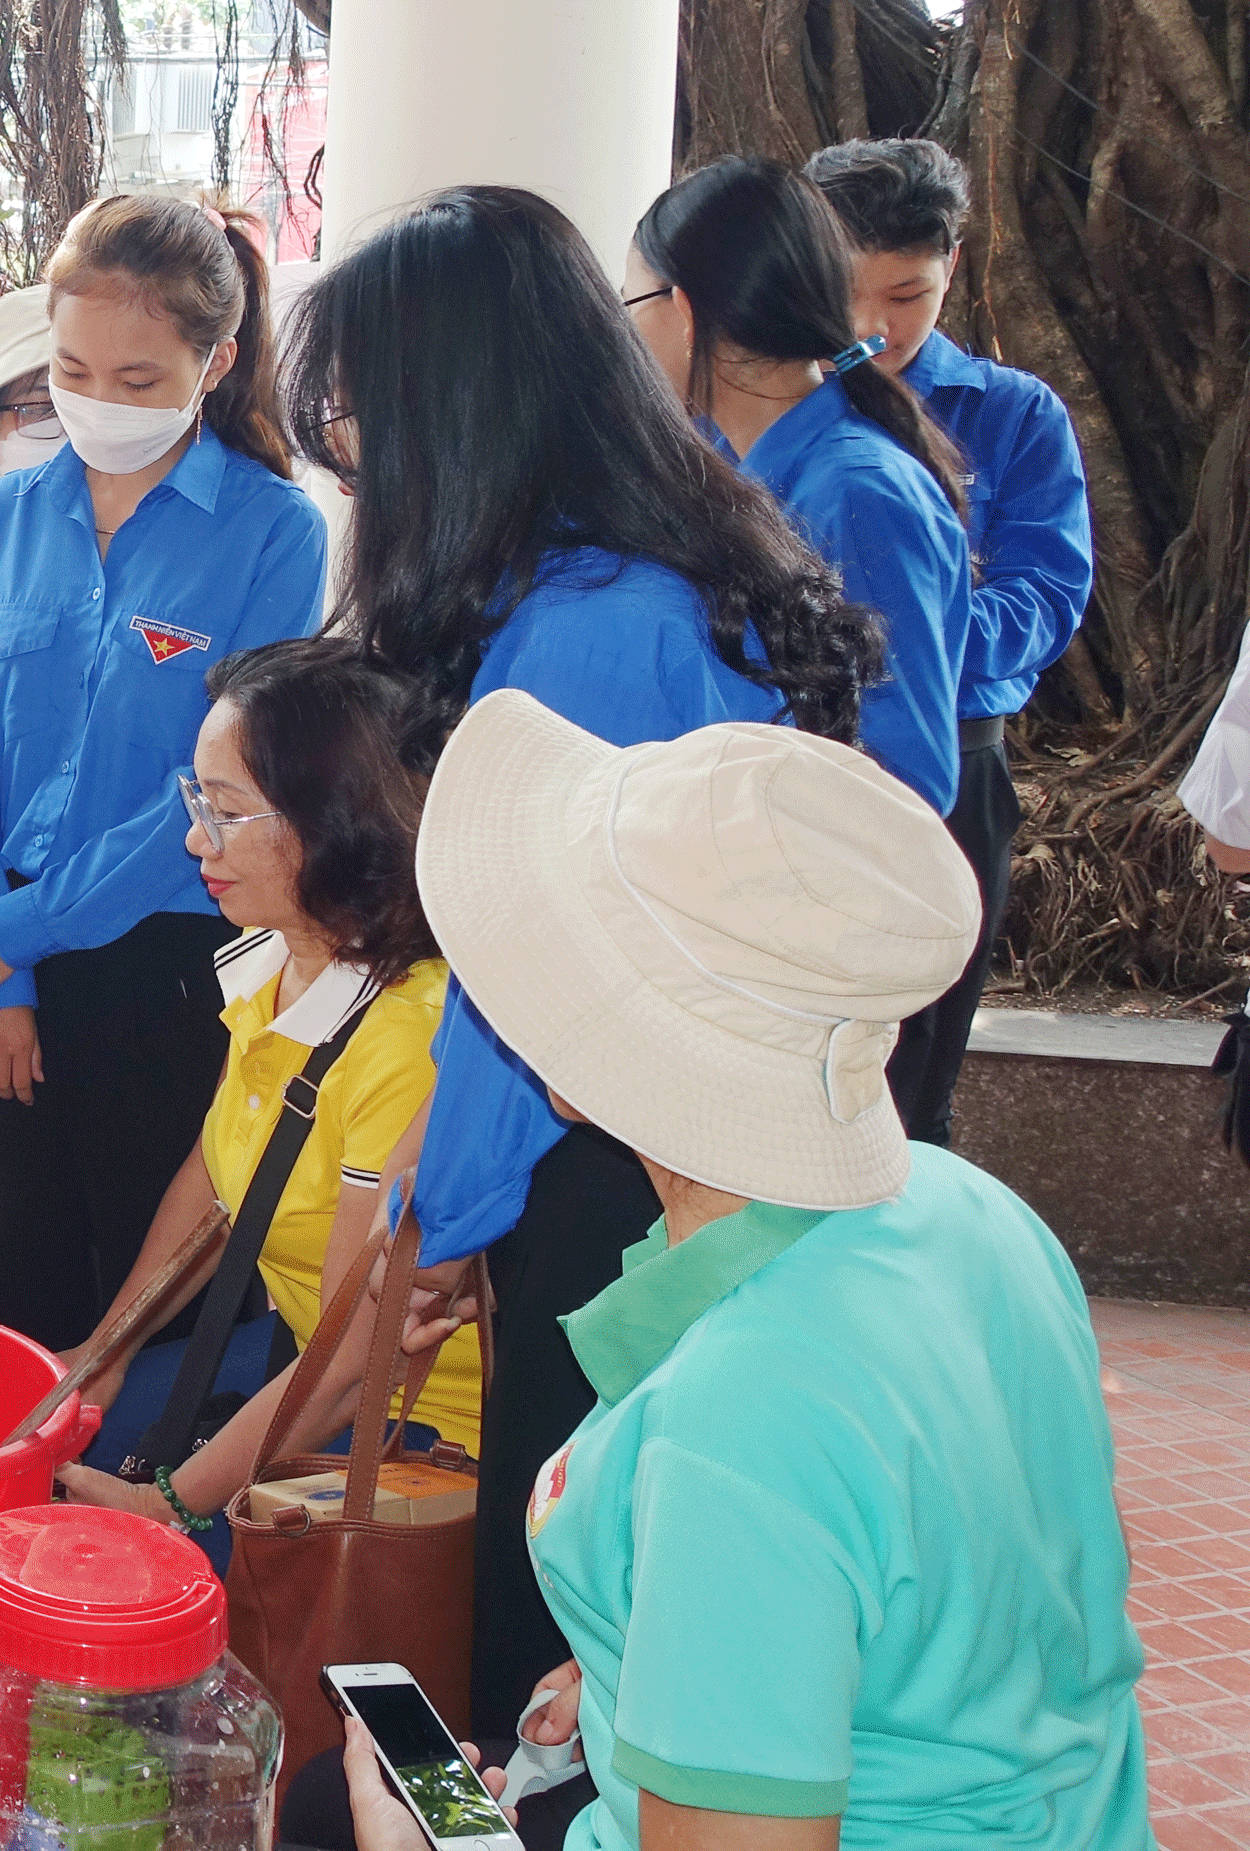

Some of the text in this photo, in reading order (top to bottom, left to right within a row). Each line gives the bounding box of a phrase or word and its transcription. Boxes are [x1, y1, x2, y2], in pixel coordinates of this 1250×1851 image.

[135, 620, 206, 647] THANH NIÊN VIỆT NAM
